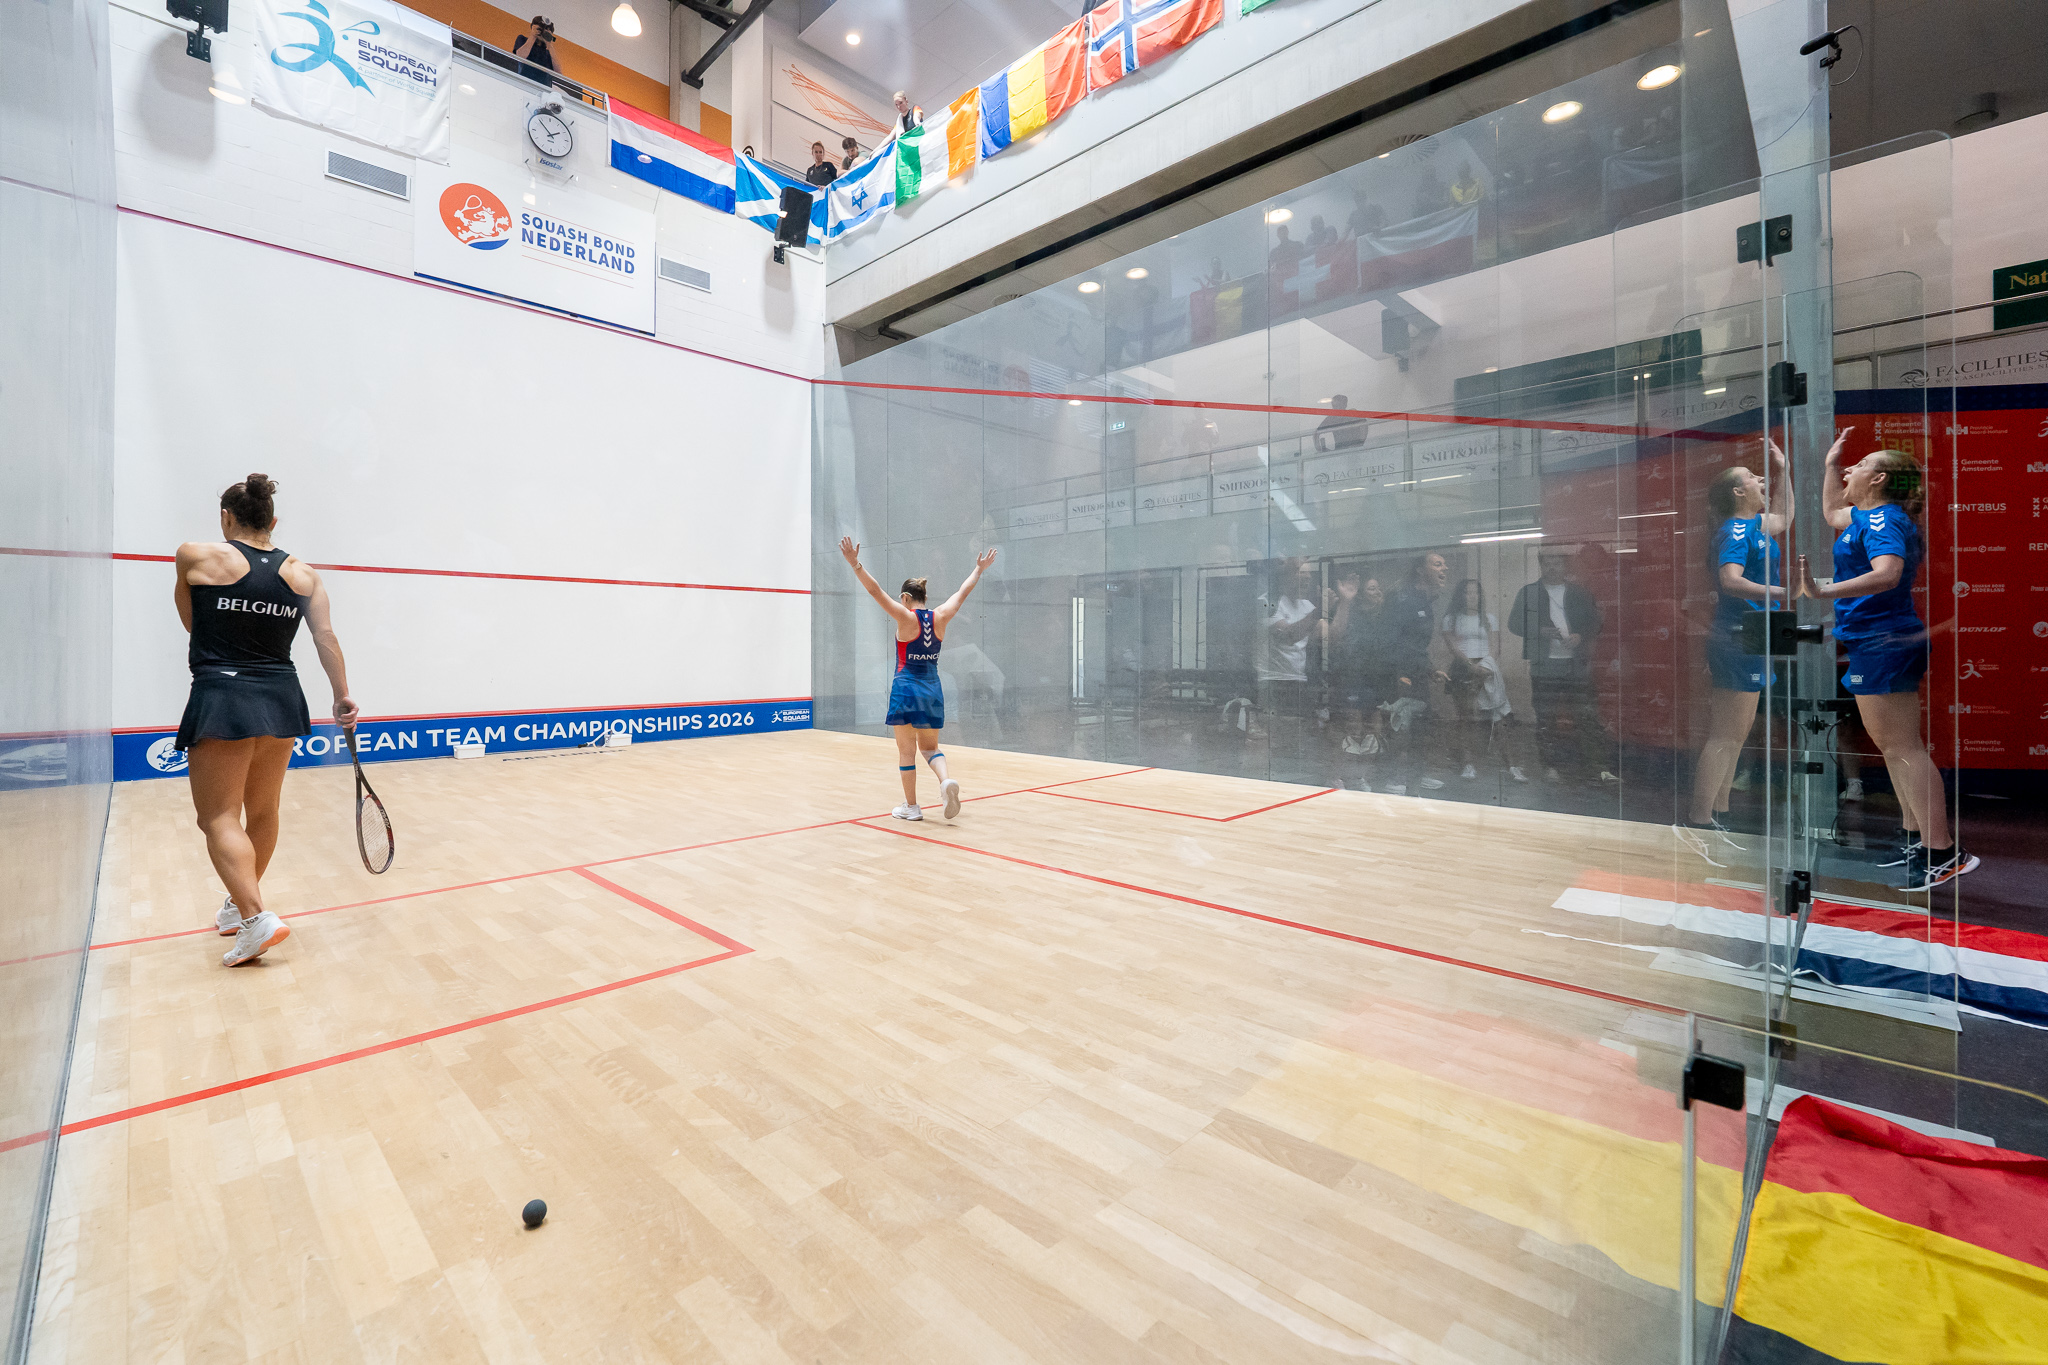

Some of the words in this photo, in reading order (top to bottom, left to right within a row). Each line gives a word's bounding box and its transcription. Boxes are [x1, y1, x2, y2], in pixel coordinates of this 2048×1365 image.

[358, 38, 437, 75] EUROPEAN
[358, 49, 437, 87] SQUASH
[521, 213, 588, 244] SQUASH
[593, 236, 635, 258] BOND
[521, 227, 635, 274] NEDERLAND
[1937, 350, 2048, 377] FACILITIES
[1333, 463, 1395, 480] FACILITIES
[216, 597, 298, 619] BELGIUM
[426, 725, 506, 747] TEAM
[513, 714, 702, 741] CHAMPIONSHIPS
[707, 711, 755, 729] 2026
